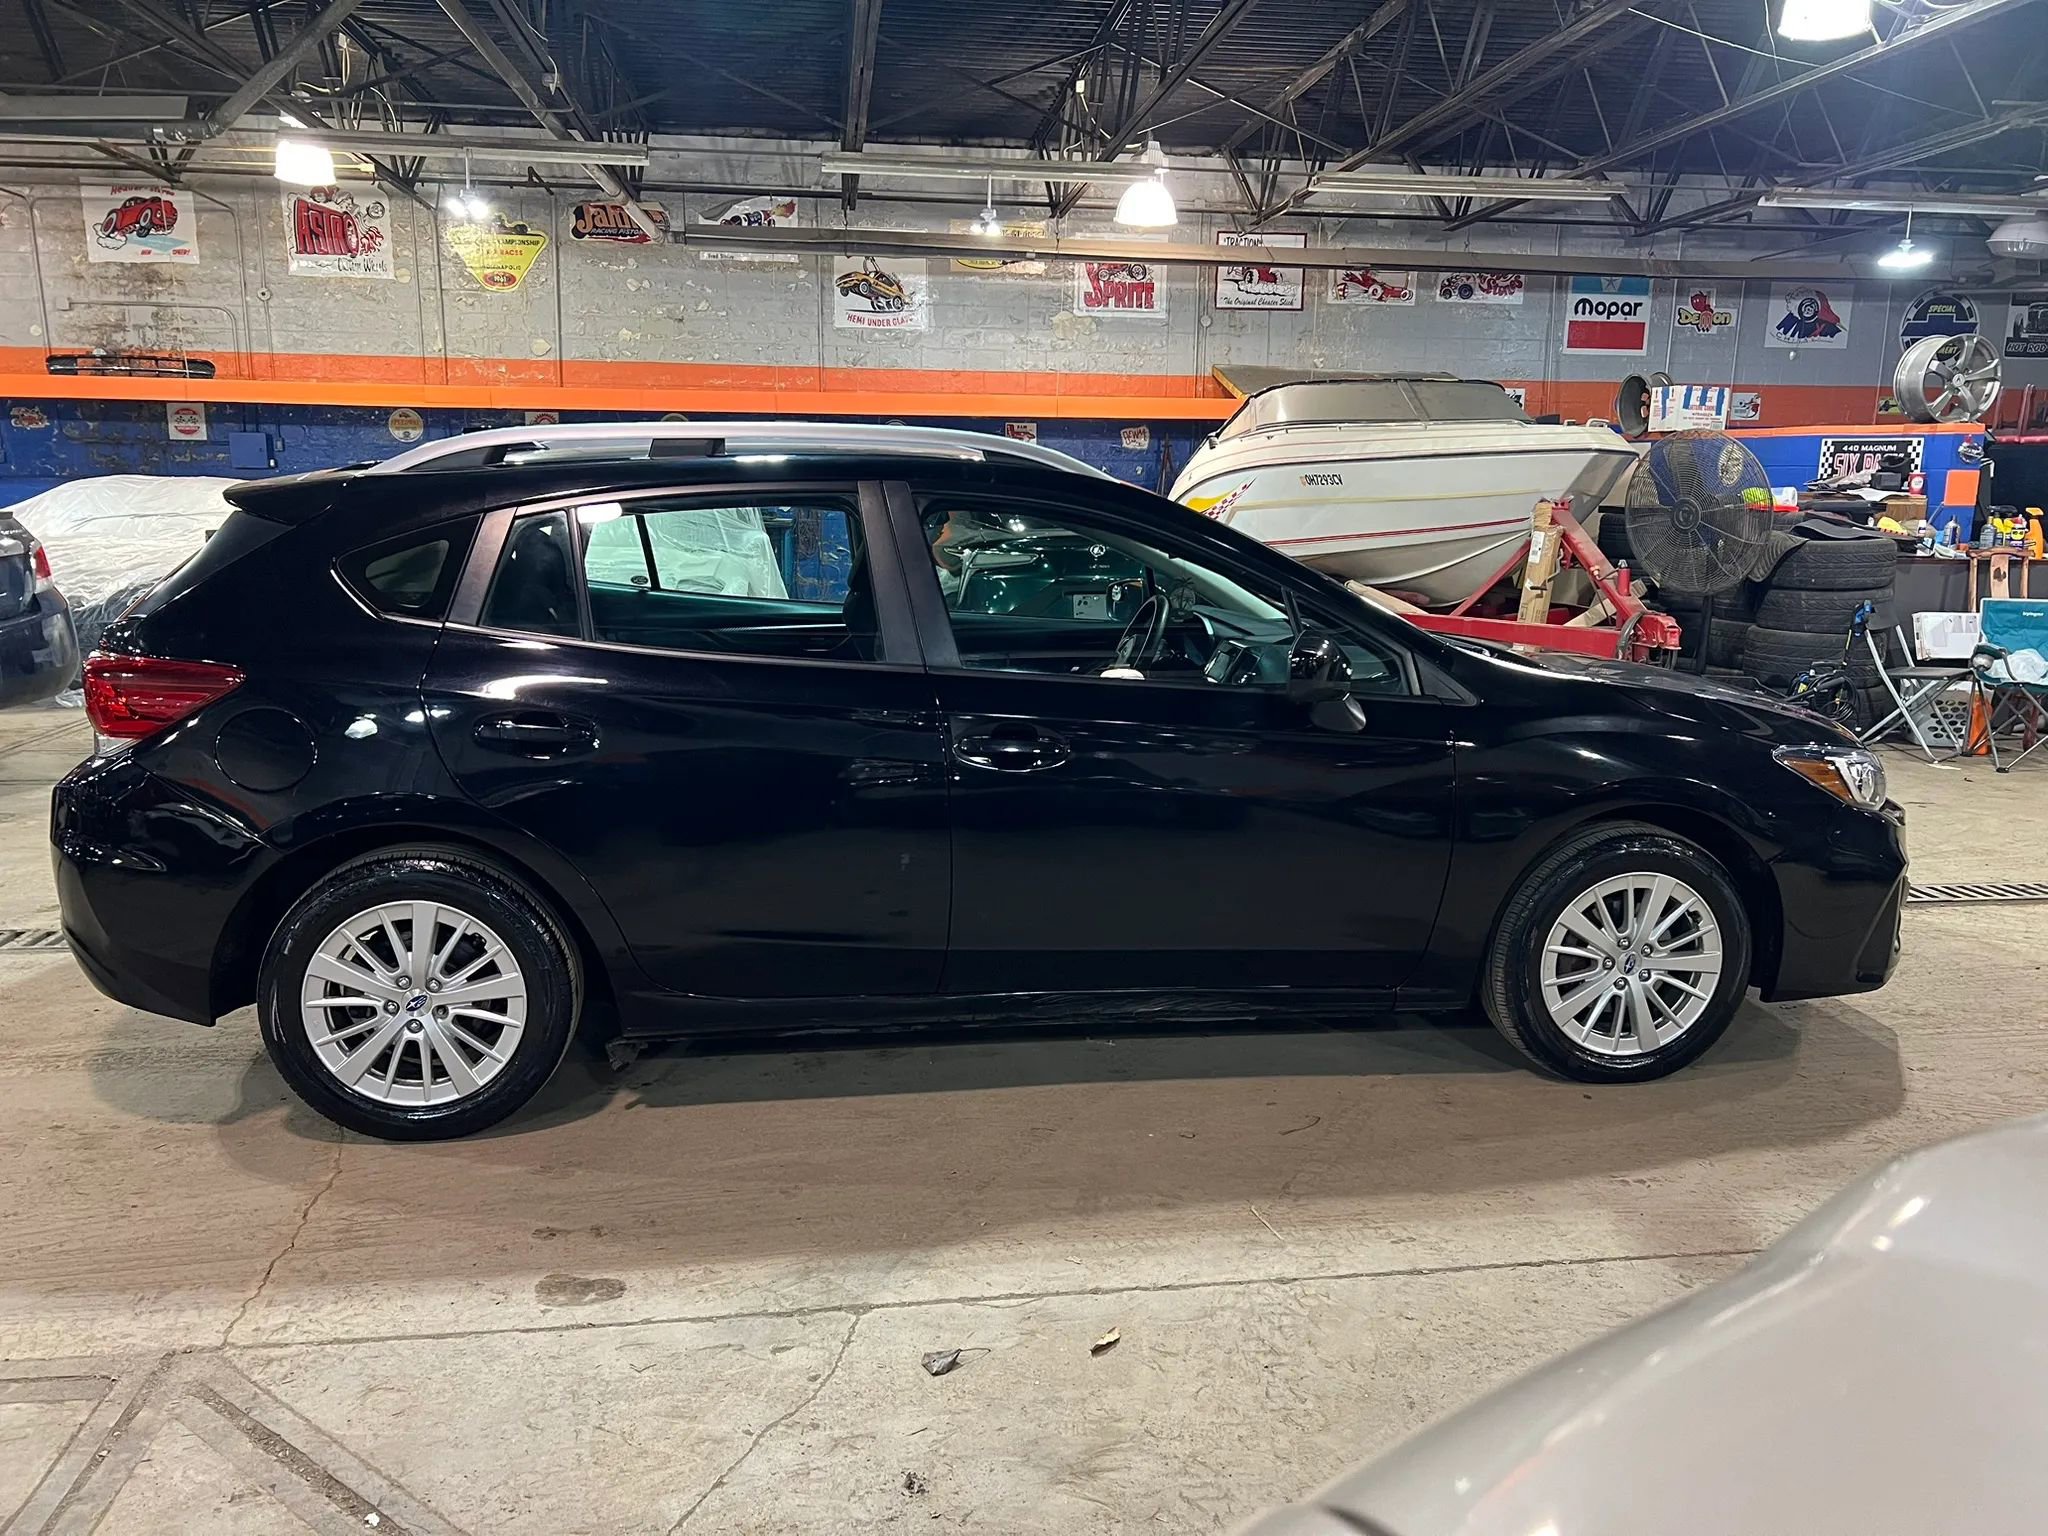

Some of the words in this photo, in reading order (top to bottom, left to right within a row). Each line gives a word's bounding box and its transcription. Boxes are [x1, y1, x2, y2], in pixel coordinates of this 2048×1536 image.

[1084, 264, 1155, 309] SPRITE
[1928, 304, 1957, 313] SPECIAL
[867, 318, 891, 327] UNDER
[2006, 341, 2027, 353] HOT
[2026, 342, 2048, 353] ROD
[1833, 453, 1860, 477] SIX
